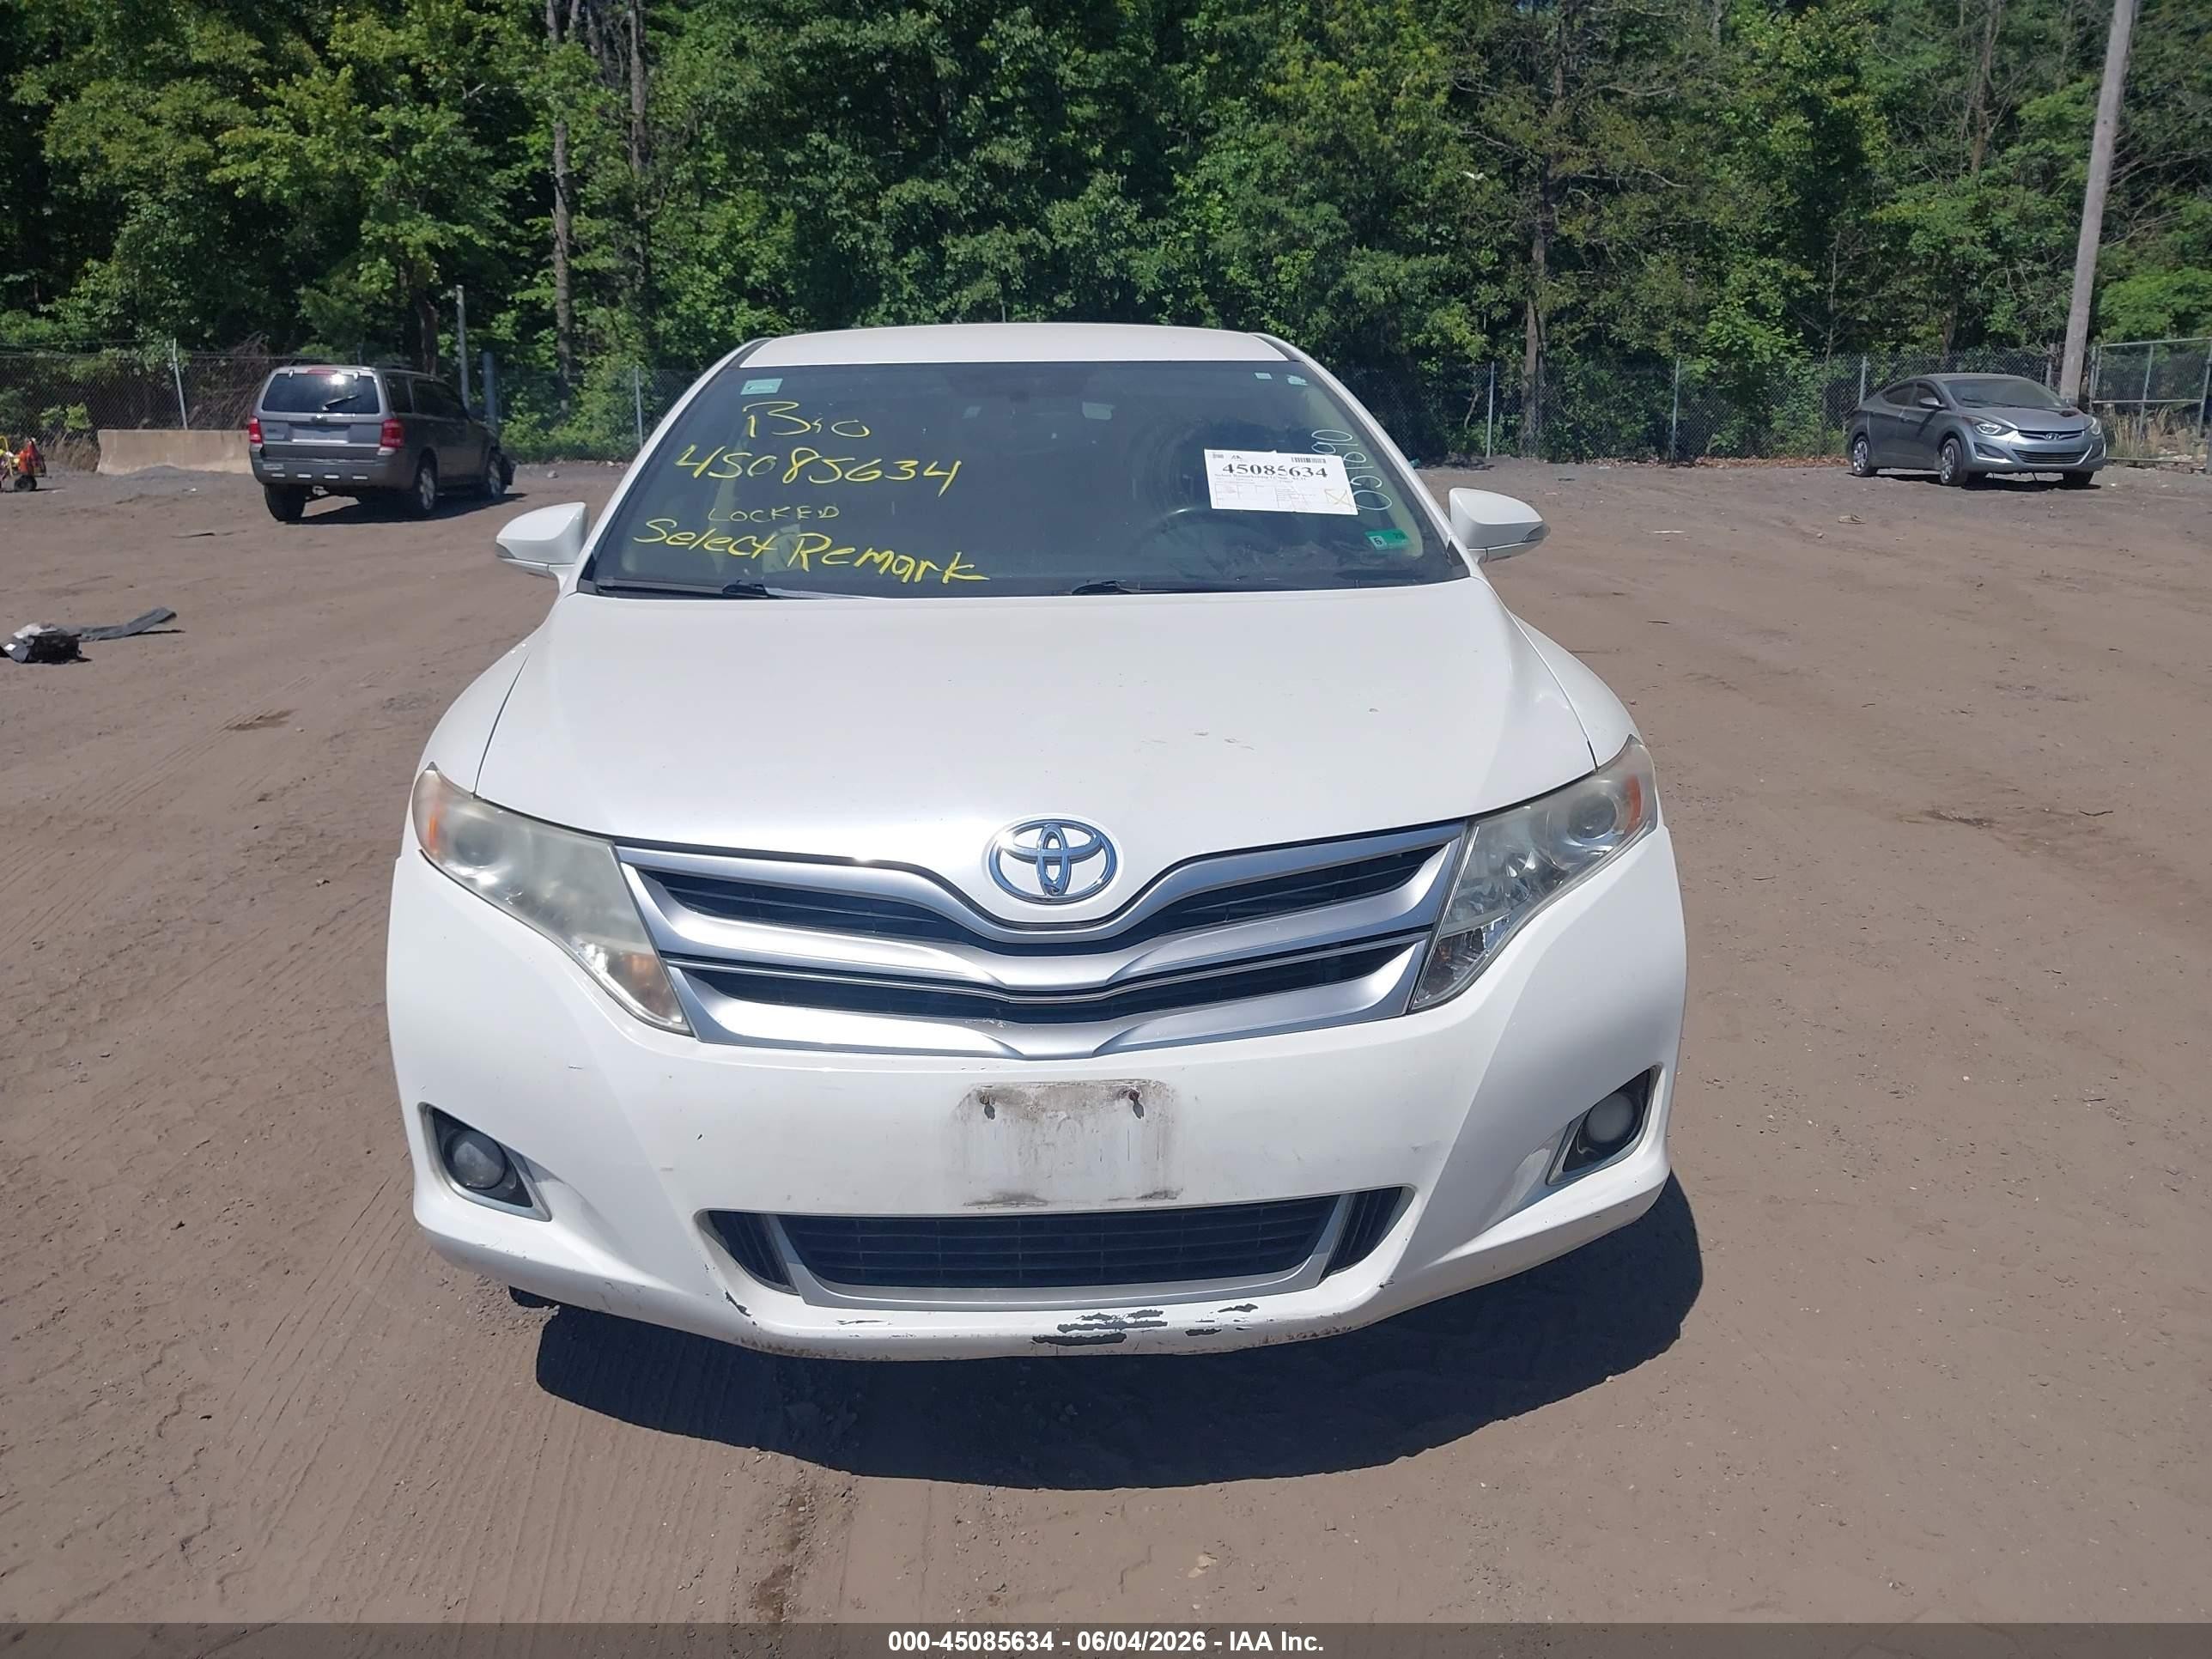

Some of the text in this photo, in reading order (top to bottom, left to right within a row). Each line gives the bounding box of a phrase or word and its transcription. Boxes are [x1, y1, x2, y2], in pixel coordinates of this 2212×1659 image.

[674, 444, 963, 498] 45085634
[1222, 463, 1328, 478] 45085634
[708, 505, 841, 524] LOCKED
[633, 518, 991, 585] Select Remark
